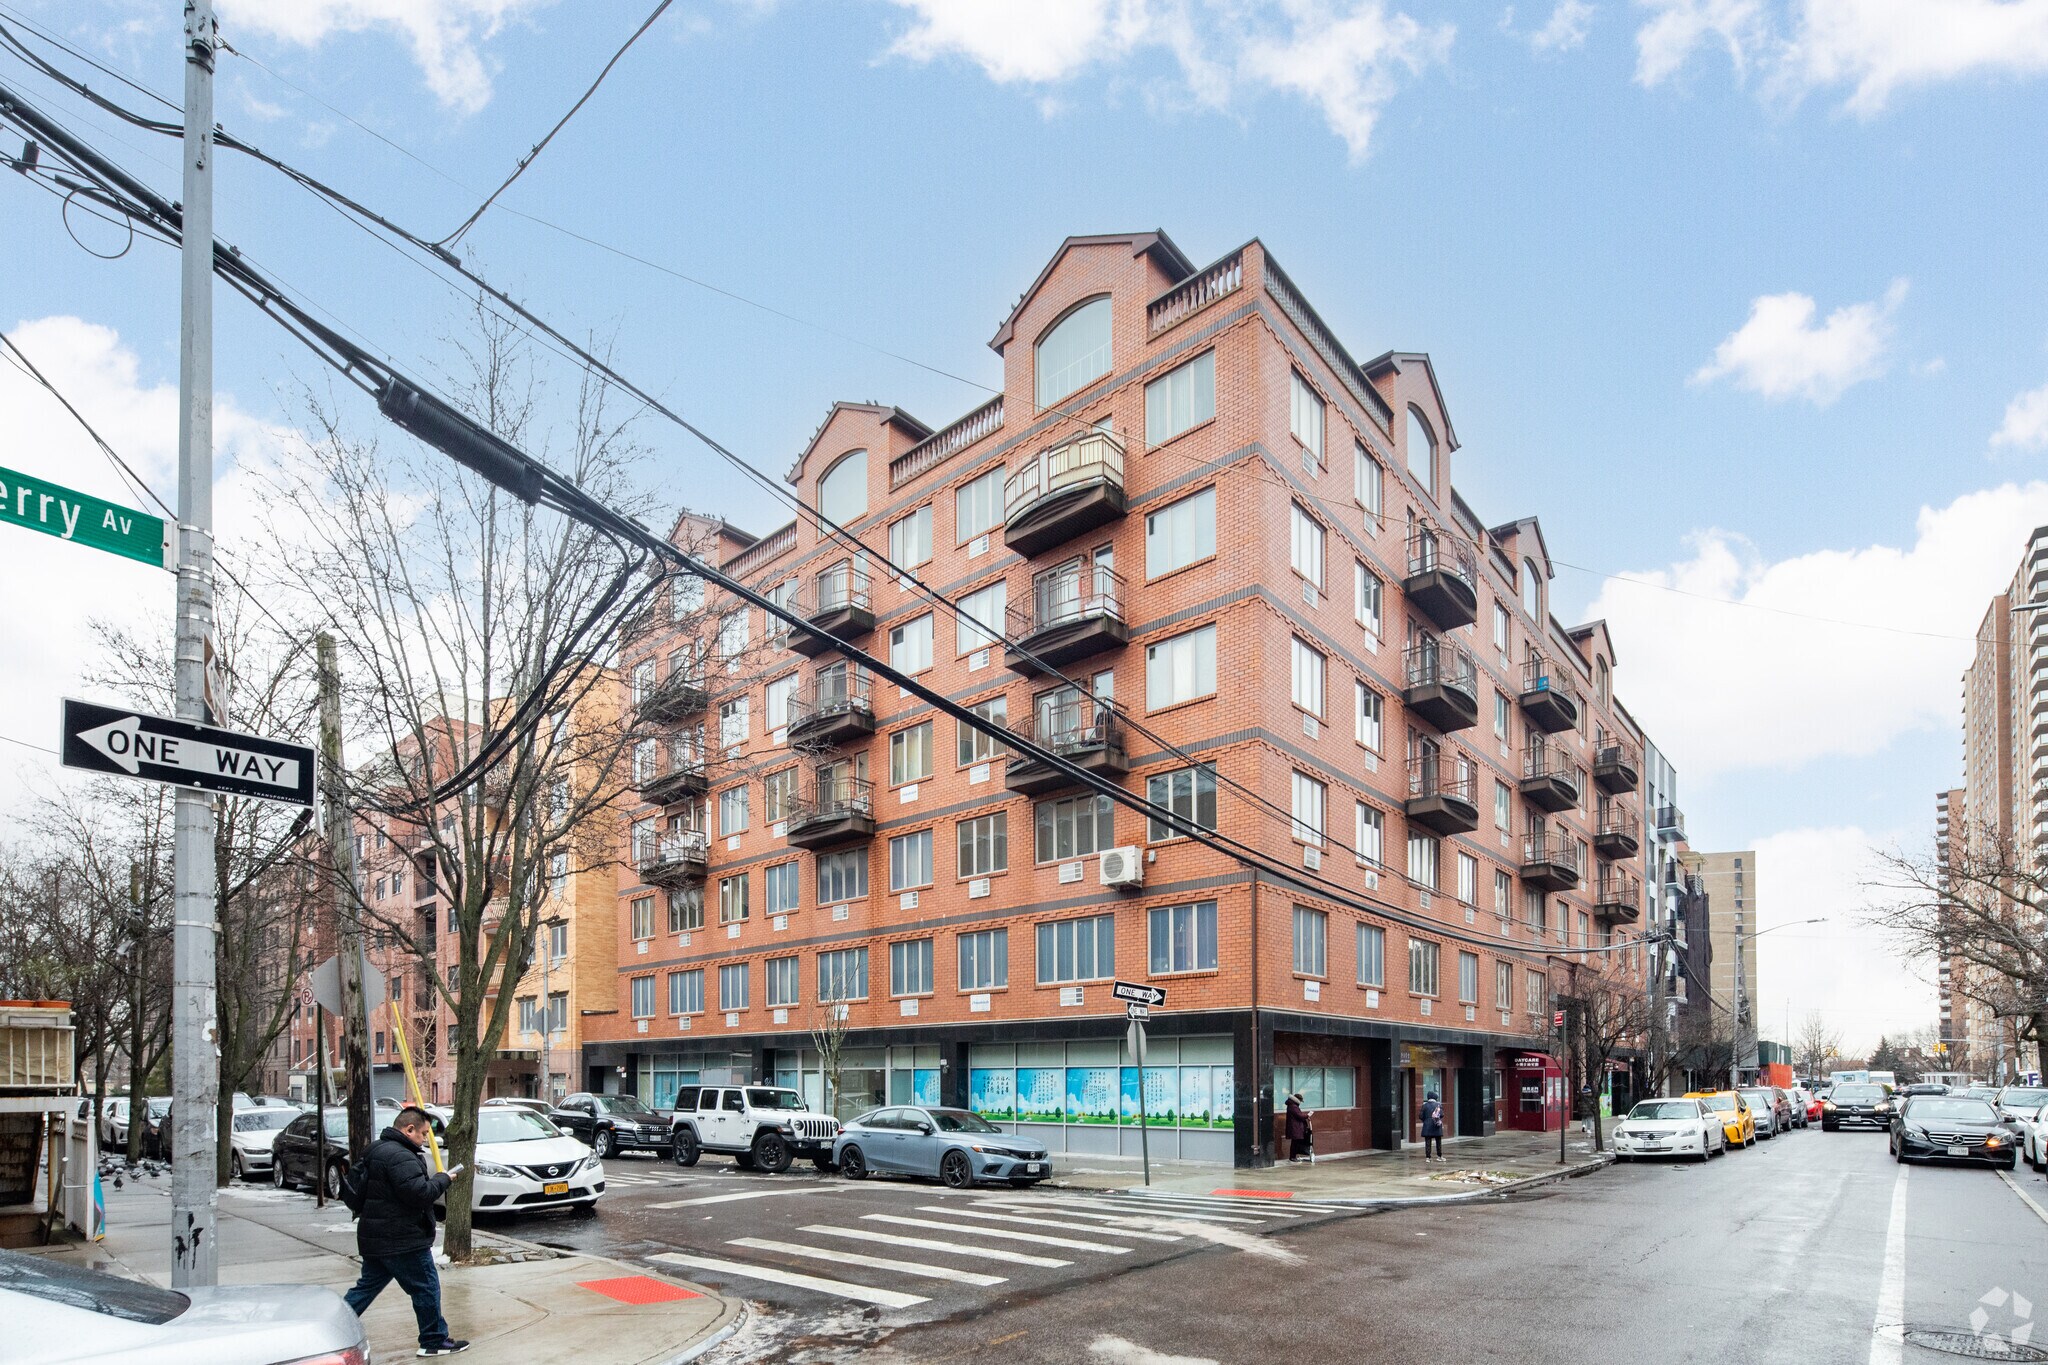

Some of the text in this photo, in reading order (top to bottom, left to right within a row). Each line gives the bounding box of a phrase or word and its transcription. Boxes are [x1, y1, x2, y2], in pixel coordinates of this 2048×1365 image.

[102, 508, 132, 535] Av
[107, 729, 285, 782] ONE WAY
[253, 791, 305, 804] TRANSPORTATION
[1120, 987, 1158, 1000] ONE WAY
